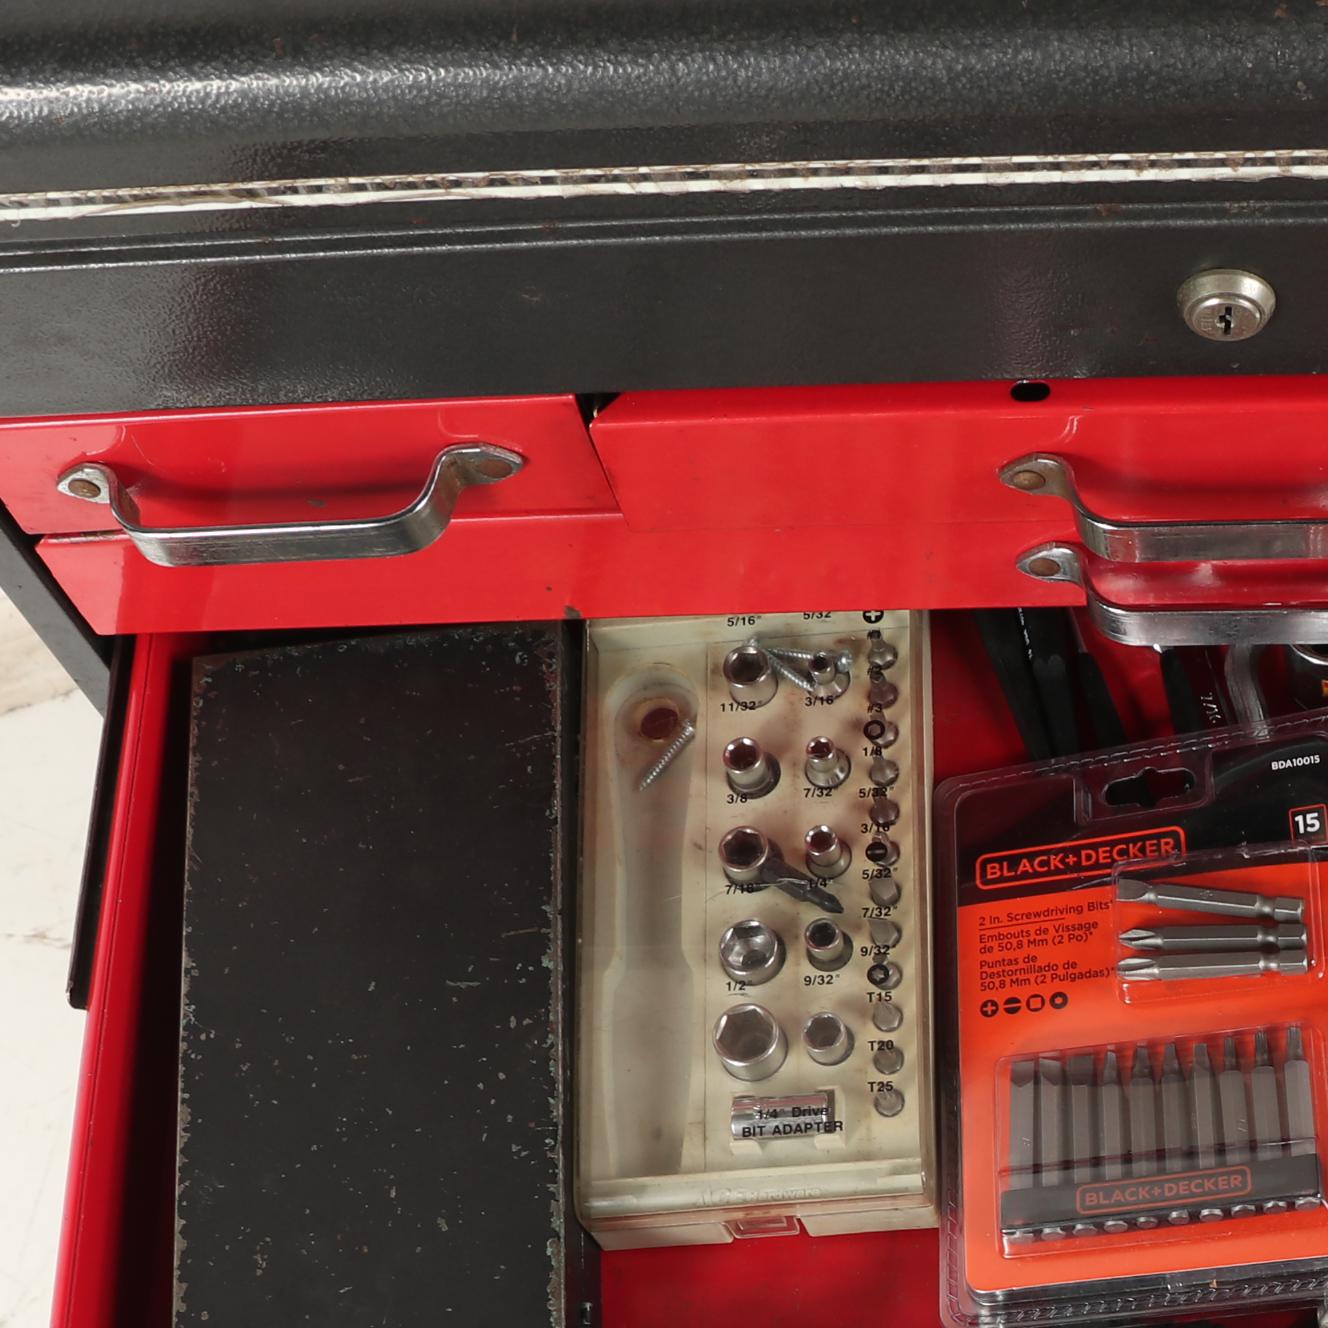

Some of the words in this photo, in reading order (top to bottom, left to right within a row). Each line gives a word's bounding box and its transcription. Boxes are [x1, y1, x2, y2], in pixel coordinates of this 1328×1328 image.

[1271, 754, 1321, 771] BDA10015
[1294, 812, 1321, 834] 15
[985, 836, 1176, 880] BLACK+DECKER
[978, 916, 986, 926] 2
[1007, 905, 1084, 922] Screwdriving
[980, 929, 1031, 943] Embouts
[1034, 926, 1050, 936] de
[1053, 920, 1099, 934] Vissage
[979, 944, 994, 954] de
[1027, 936, 1048, 947] Mm
[1052, 935, 1065, 946] (2
[980, 957, 1019, 970] Puntas
[1022, 954, 1038, 964] de
[980, 962, 1059, 980] Destornillado
[1062, 960, 1078, 970] de
[803, 973, 841, 986] 9/32"
[1010, 977, 1031, 988] Mm
[1034, 974, 1047, 986] (2
[866, 992, 892, 1002] T15
[867, 1040, 894, 1050] T20
[867, 1081, 894, 1092] T25
[791, 1106, 829, 1118] Drive
[742, 1125, 766, 1138] BIT
[772, 1120, 843, 1136] ADAPTER
[1085, 1173, 1243, 1207] BLACK+DECKER
